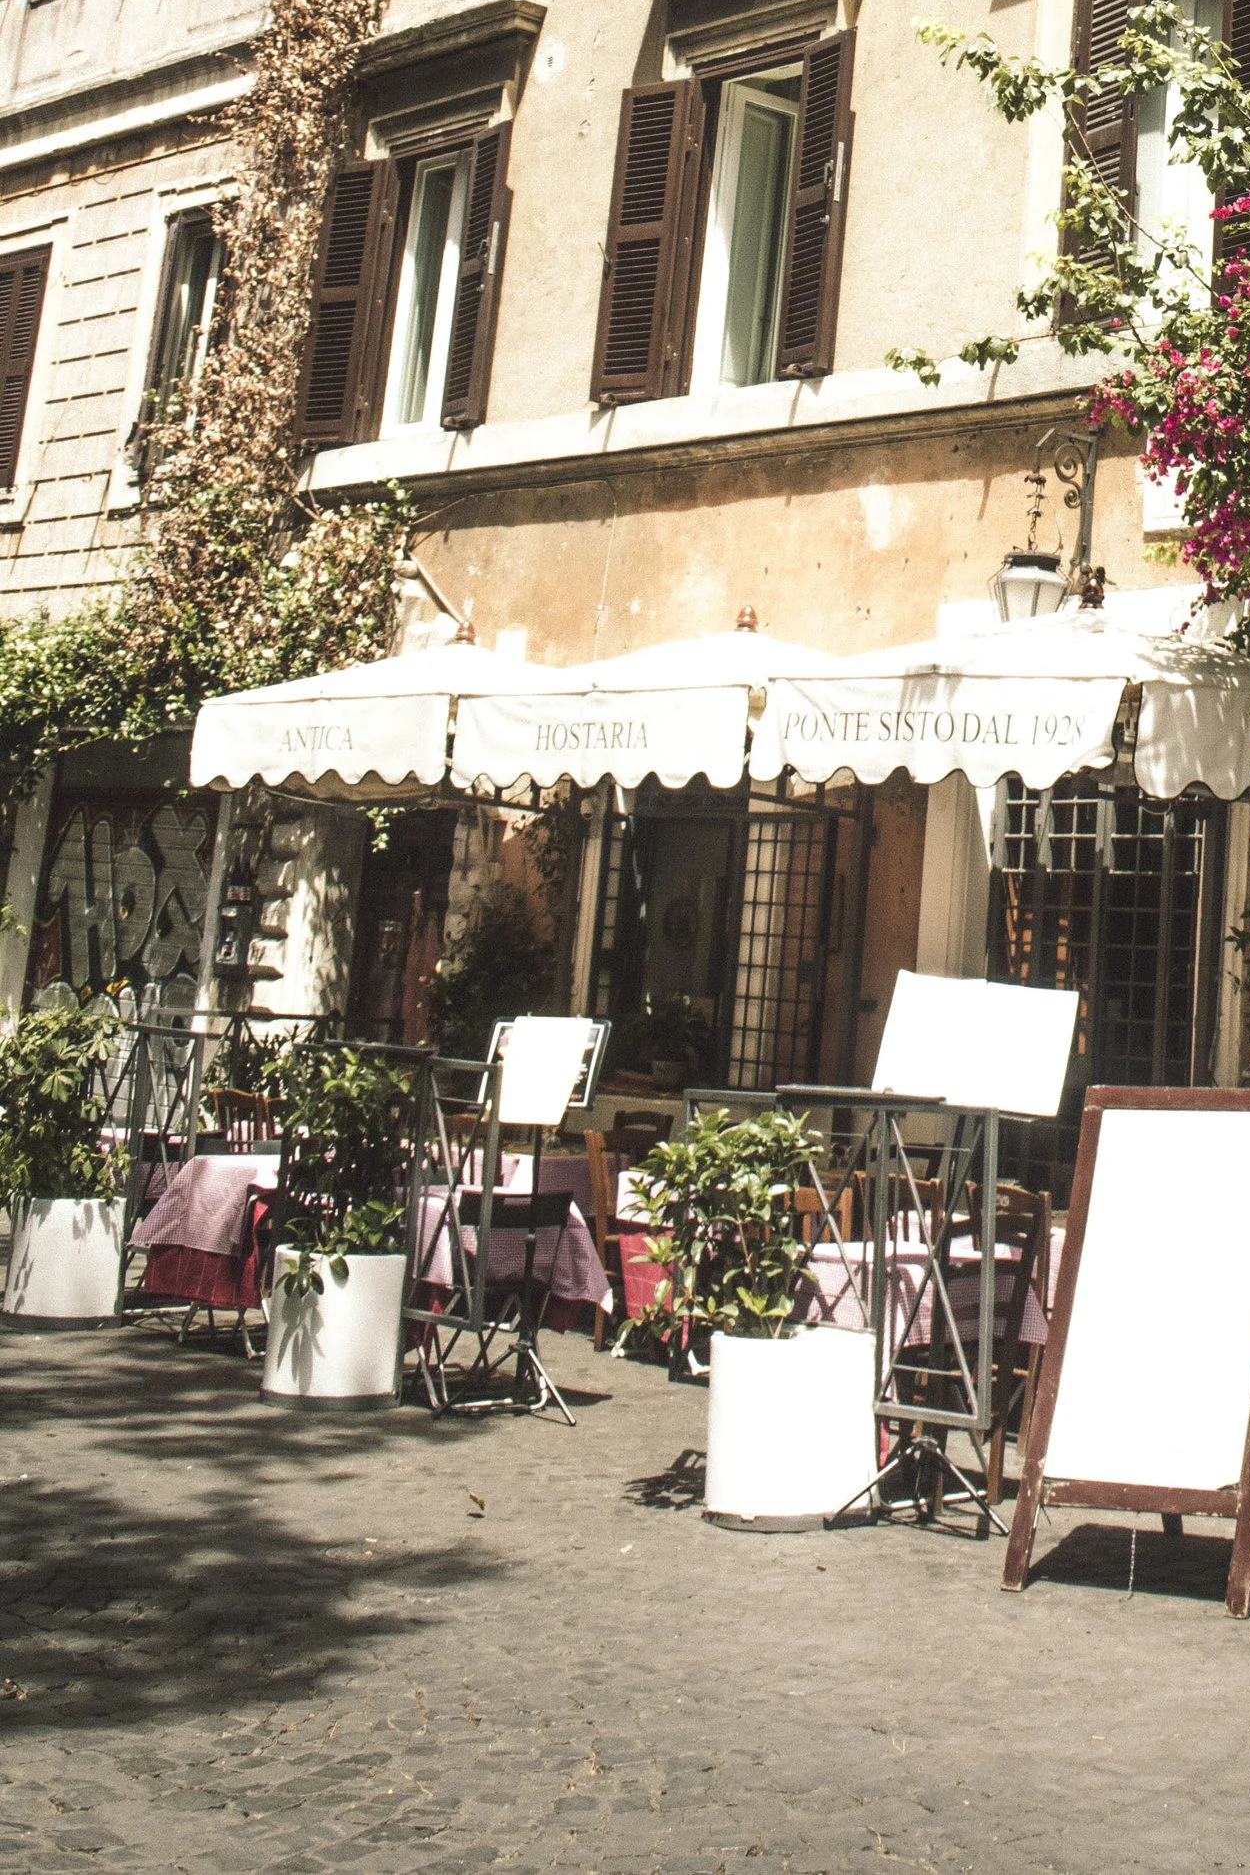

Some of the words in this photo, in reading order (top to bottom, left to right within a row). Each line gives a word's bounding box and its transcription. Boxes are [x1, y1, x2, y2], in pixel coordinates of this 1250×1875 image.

[278, 725, 353, 752] ANTICA
[536, 722, 648, 750] HOSTARIA
[784, 711, 869, 742] PONTE
[878, 711, 955, 742] SISTO
[962, 712, 1018, 745] DAL
[1032, 714, 1086, 746] 1928
